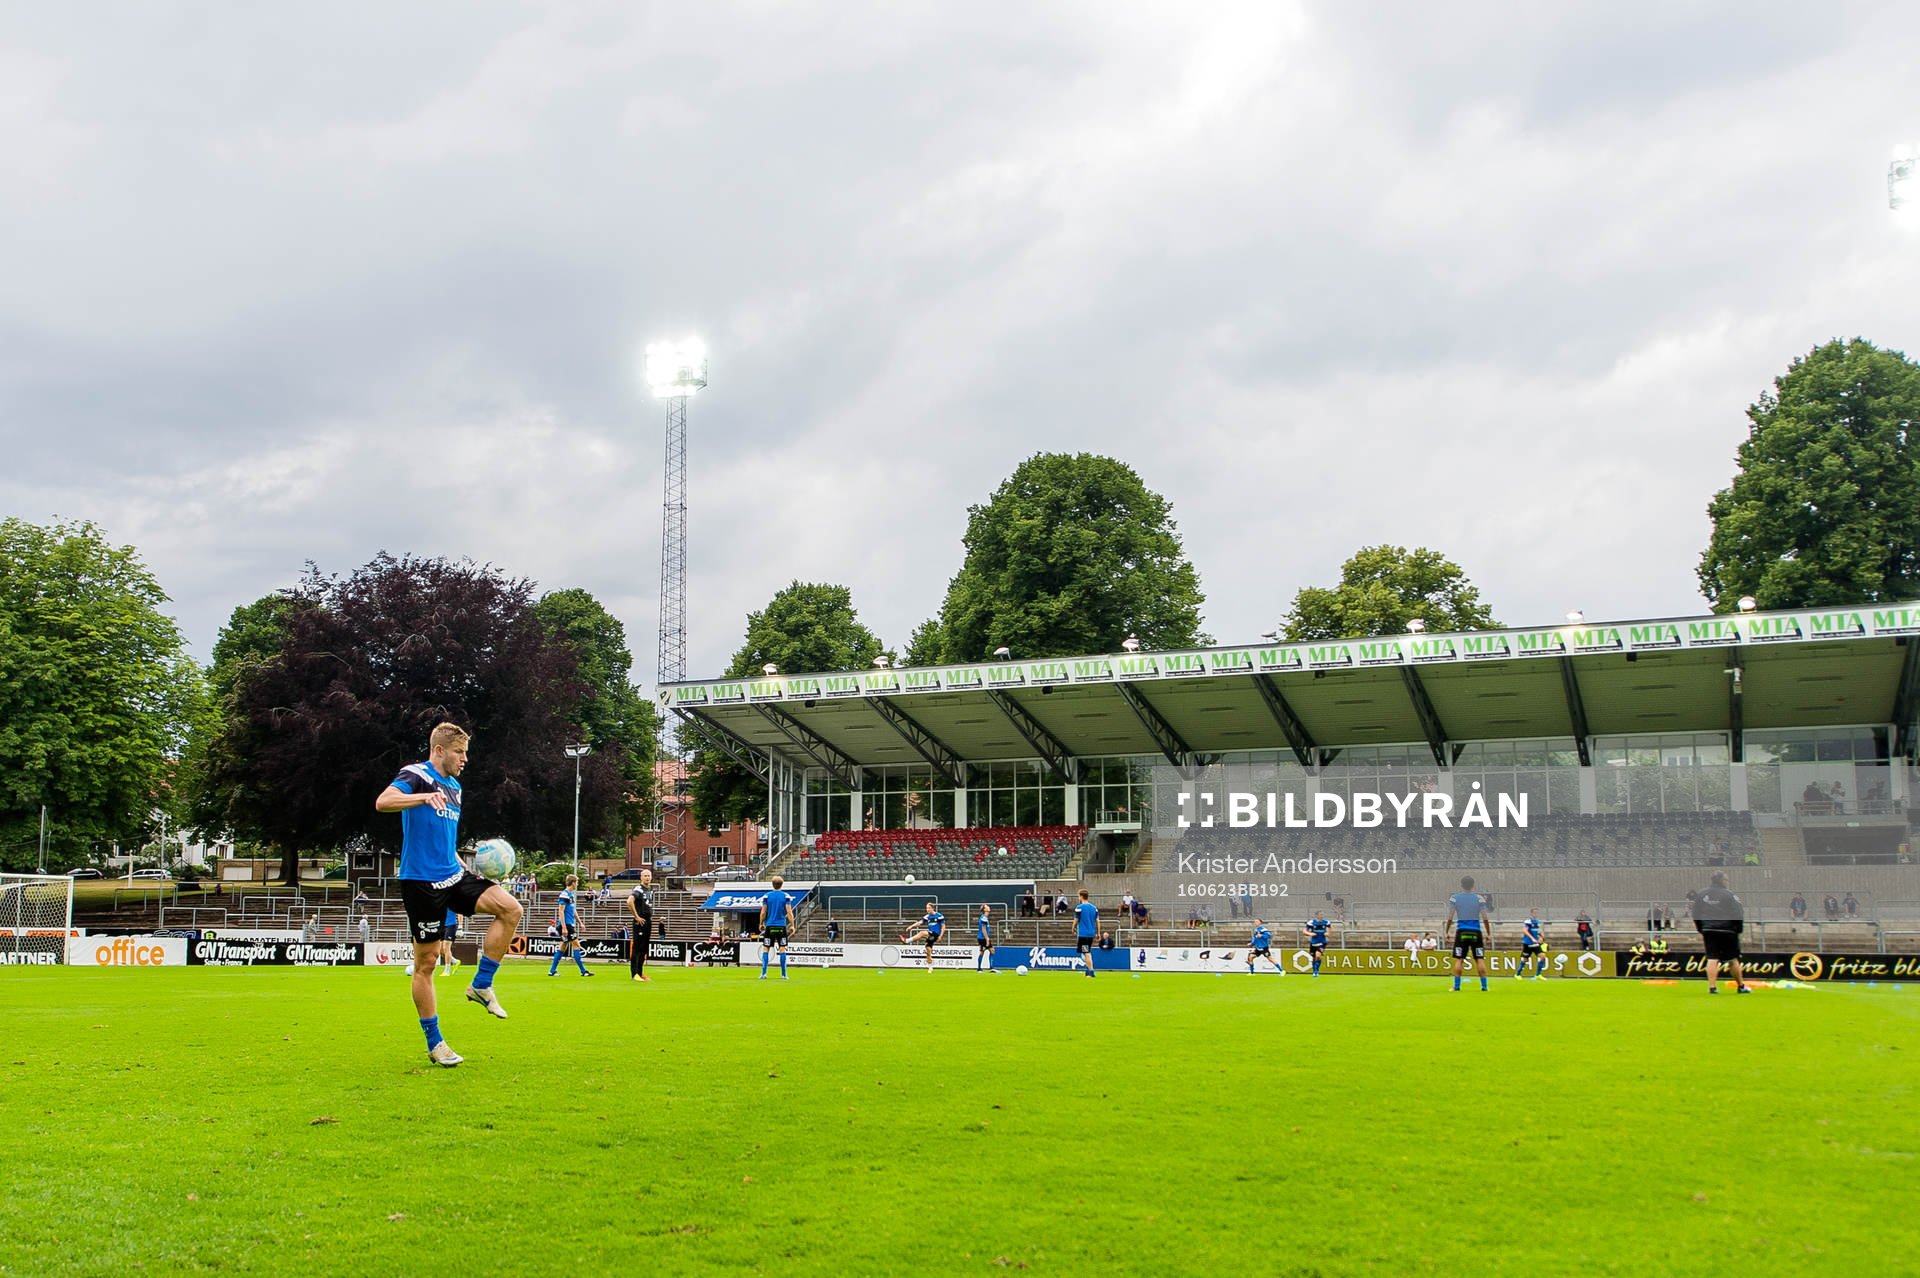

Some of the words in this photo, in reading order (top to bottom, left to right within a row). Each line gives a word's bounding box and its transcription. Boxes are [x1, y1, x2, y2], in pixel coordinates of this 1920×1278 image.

[676, 686, 708, 701] MTA
[713, 684, 745, 699] MTA
[750, 681, 782, 697] MTA
[787, 679, 821, 694] MTA
[826, 676, 859, 692] MTA
[865, 673, 900, 690] MTA
[905, 671, 940, 687] MTA
[946, 668, 981, 685] MTA
[988, 666, 1024, 682] MTA
[1031, 664, 1069, 679] MTA
[1074, 661, 1115, 676] MTA
[1119, 657, 1160, 674] MTA
[1165, 655, 1206, 672] MTA
[1211, 651, 1254, 669] MTA
[1259, 648, 1303, 666] MTA
[1309, 645, 1353, 663] MTA
[1359, 642, 1404, 660] MTA
[1411, 639, 1457, 656] MTA
[1463, 635, 1510, 654] MTA
[1518, 632, 1566, 650] MTA
[1573, 628, 1623, 647] MTA
[1630, 624, 1681, 643] MTA
[1689, 620, 1741, 640] MTA
[1748, 616, 1802, 636] MTA
[1810, 612, 1864, 632] MTA
[95, 938, 165, 966] office
[528, 939, 560, 953] Home
[649, 943, 680, 958] Home
[1029, 947, 1087, 970] Kinnarps
[1626, 955, 1681, 977] fritz
[1828, 957, 1889, 980] fritz
